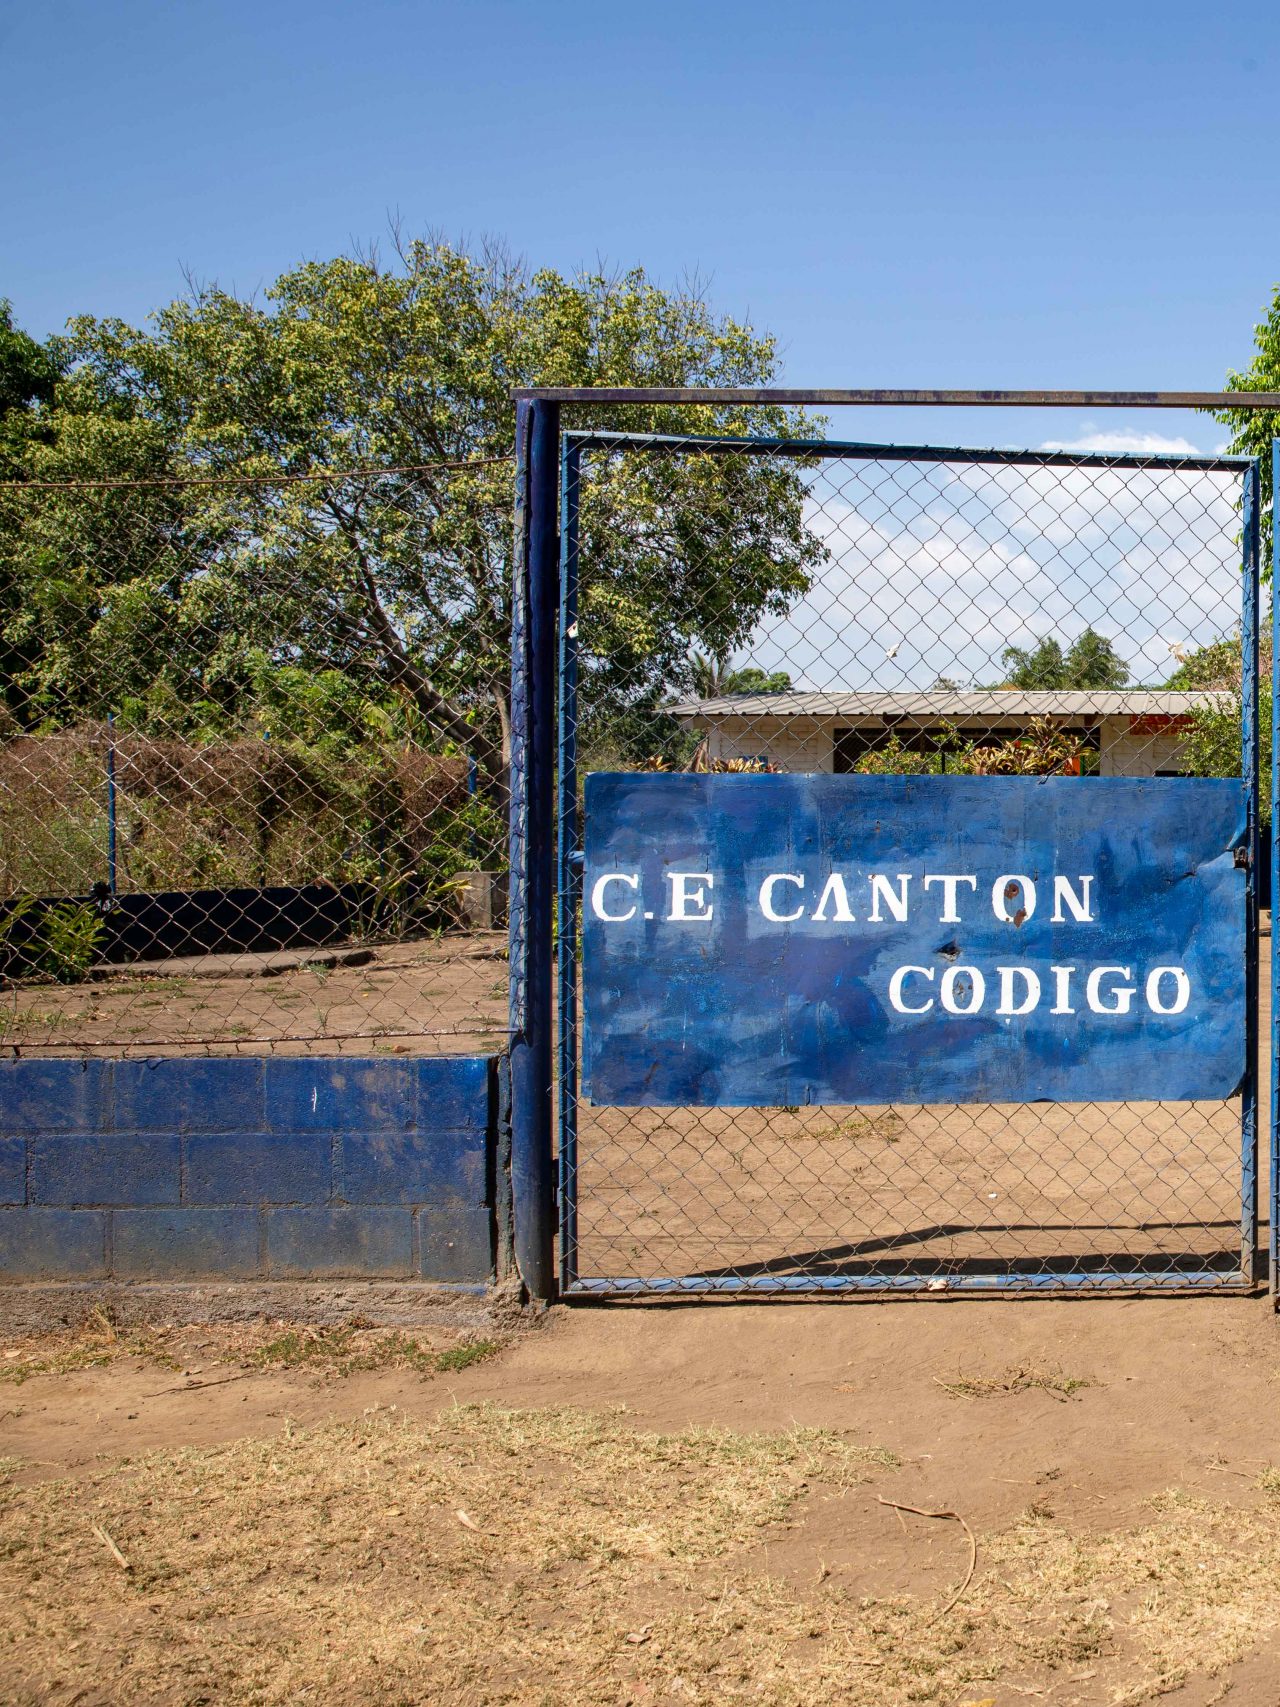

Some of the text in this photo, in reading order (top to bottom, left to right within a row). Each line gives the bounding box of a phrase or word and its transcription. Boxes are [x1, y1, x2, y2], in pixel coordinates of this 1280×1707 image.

[591, 872, 714, 923] C.E
[758, 872, 1095, 926] CANTON
[888, 965, 1191, 1016] CODIGO
